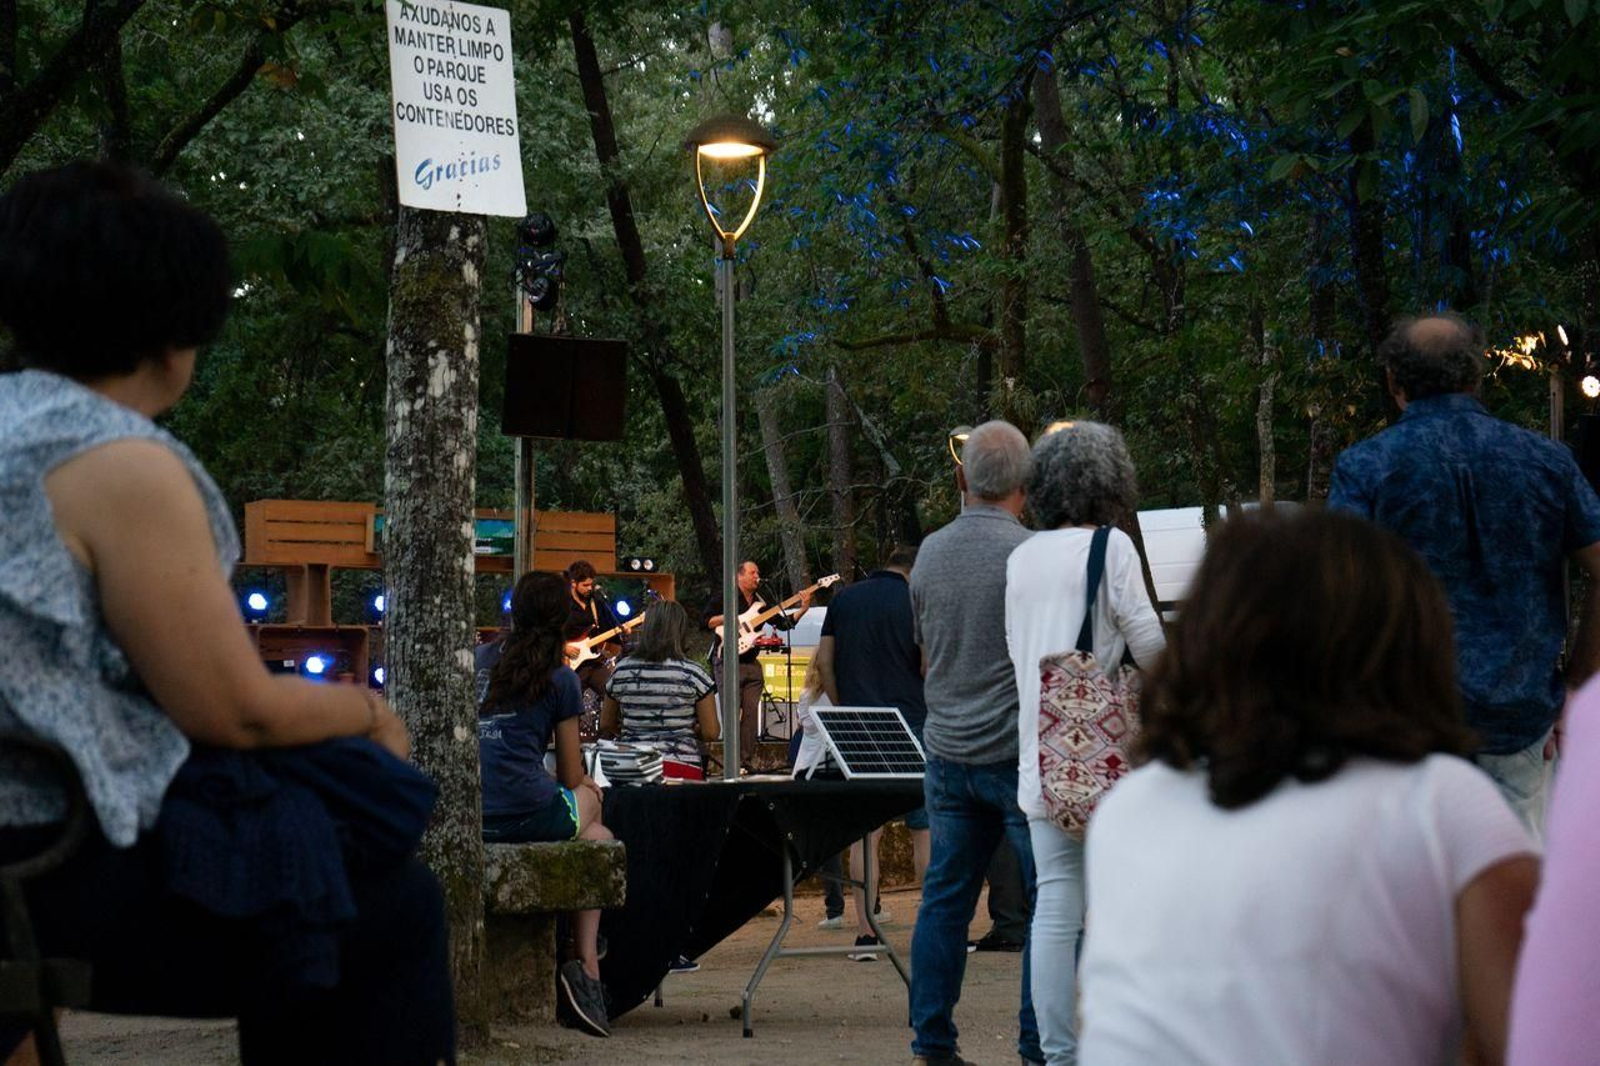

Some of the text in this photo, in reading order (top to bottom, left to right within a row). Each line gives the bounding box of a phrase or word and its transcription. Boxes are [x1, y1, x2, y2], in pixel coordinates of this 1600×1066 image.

[400, 3, 495, 36] AXUDANOS A
[395, 26, 504, 62] MANTER LIMPO
[414, 55, 486, 84] O PARQUE
[423, 82, 478, 107] USA OS
[396, 102, 515, 136] CONTENEDORES
[415, 152, 501, 190] Gracias
